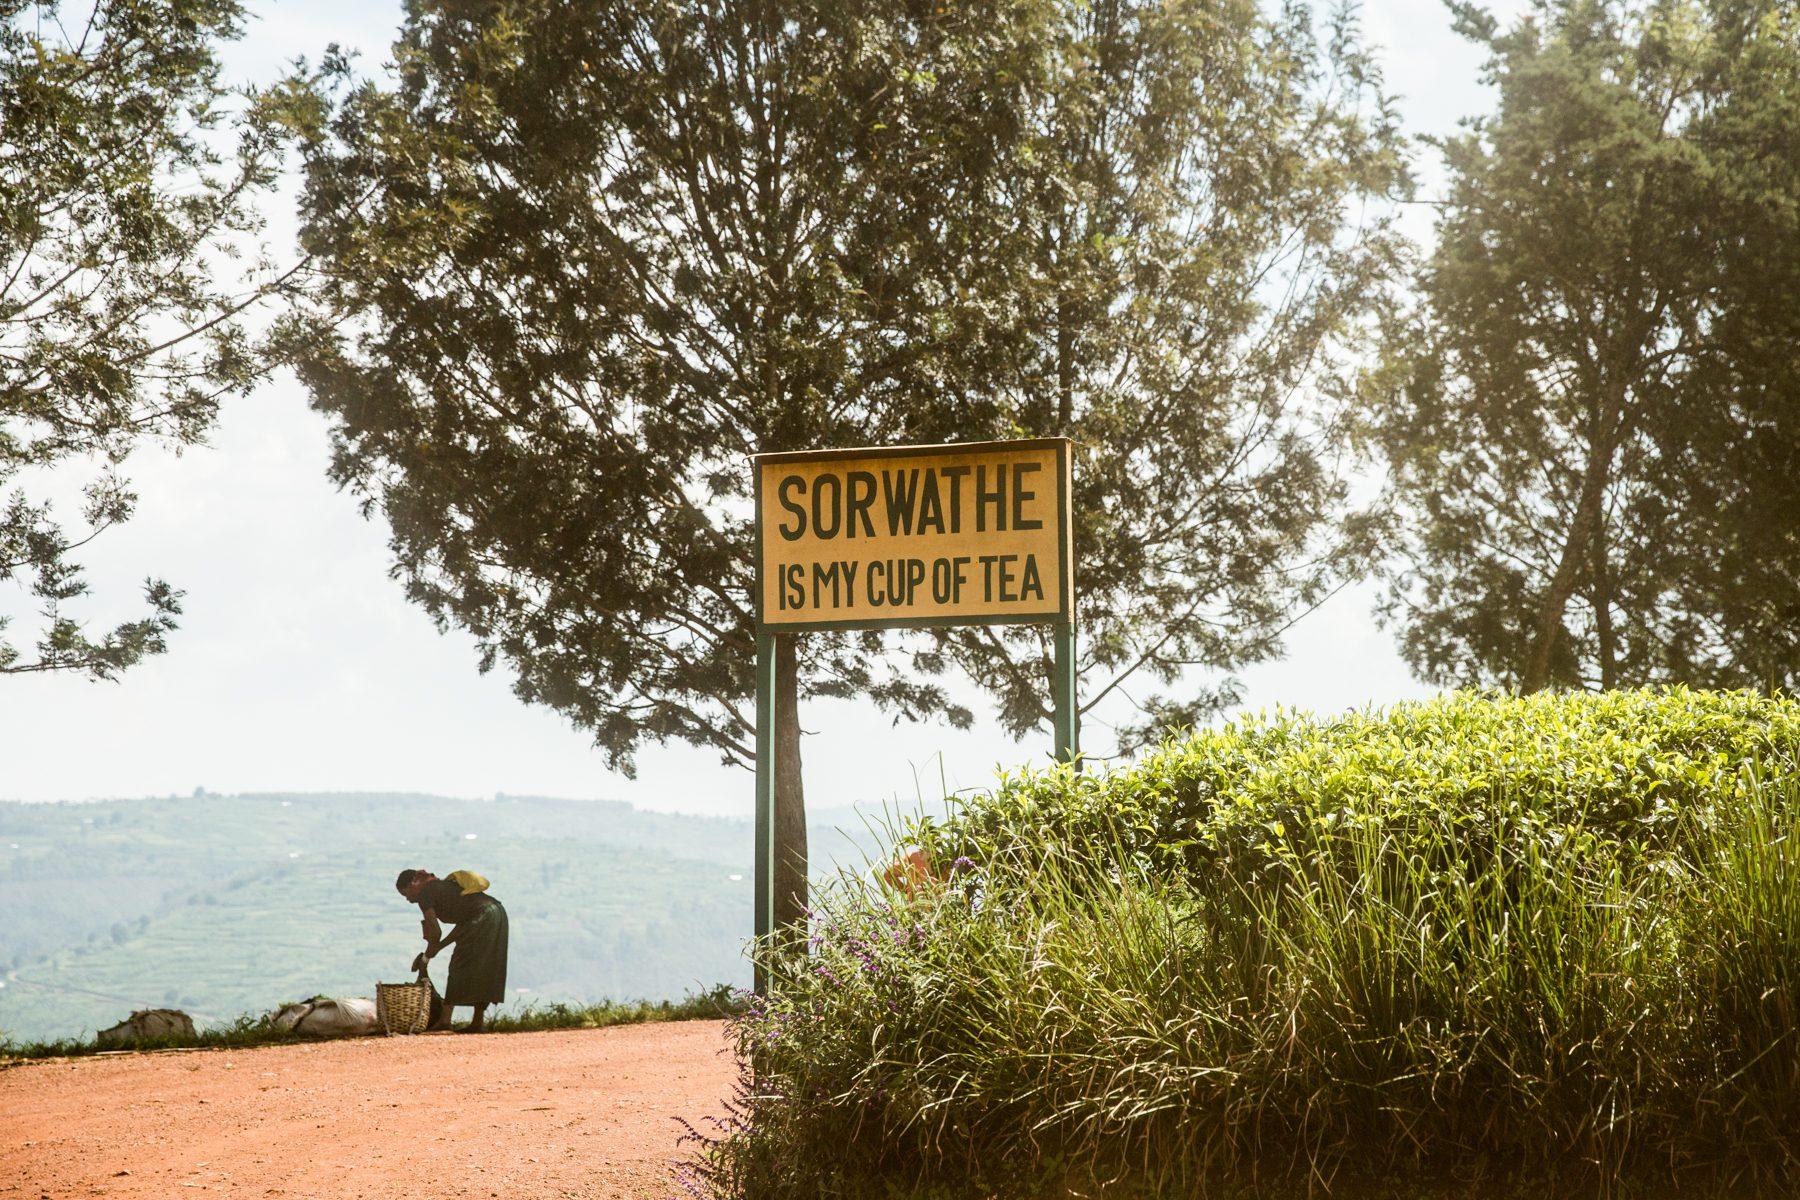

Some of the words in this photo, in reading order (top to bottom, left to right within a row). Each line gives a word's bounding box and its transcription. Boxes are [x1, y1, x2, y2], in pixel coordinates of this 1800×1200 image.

[778, 462, 1043, 541] SORWATHE
[778, 563, 805, 610] IS
[812, 561, 858, 609] MY
[866, 559, 925, 607] CUP
[932, 556, 971, 604] OF
[979, 554, 1044, 603] TEA
